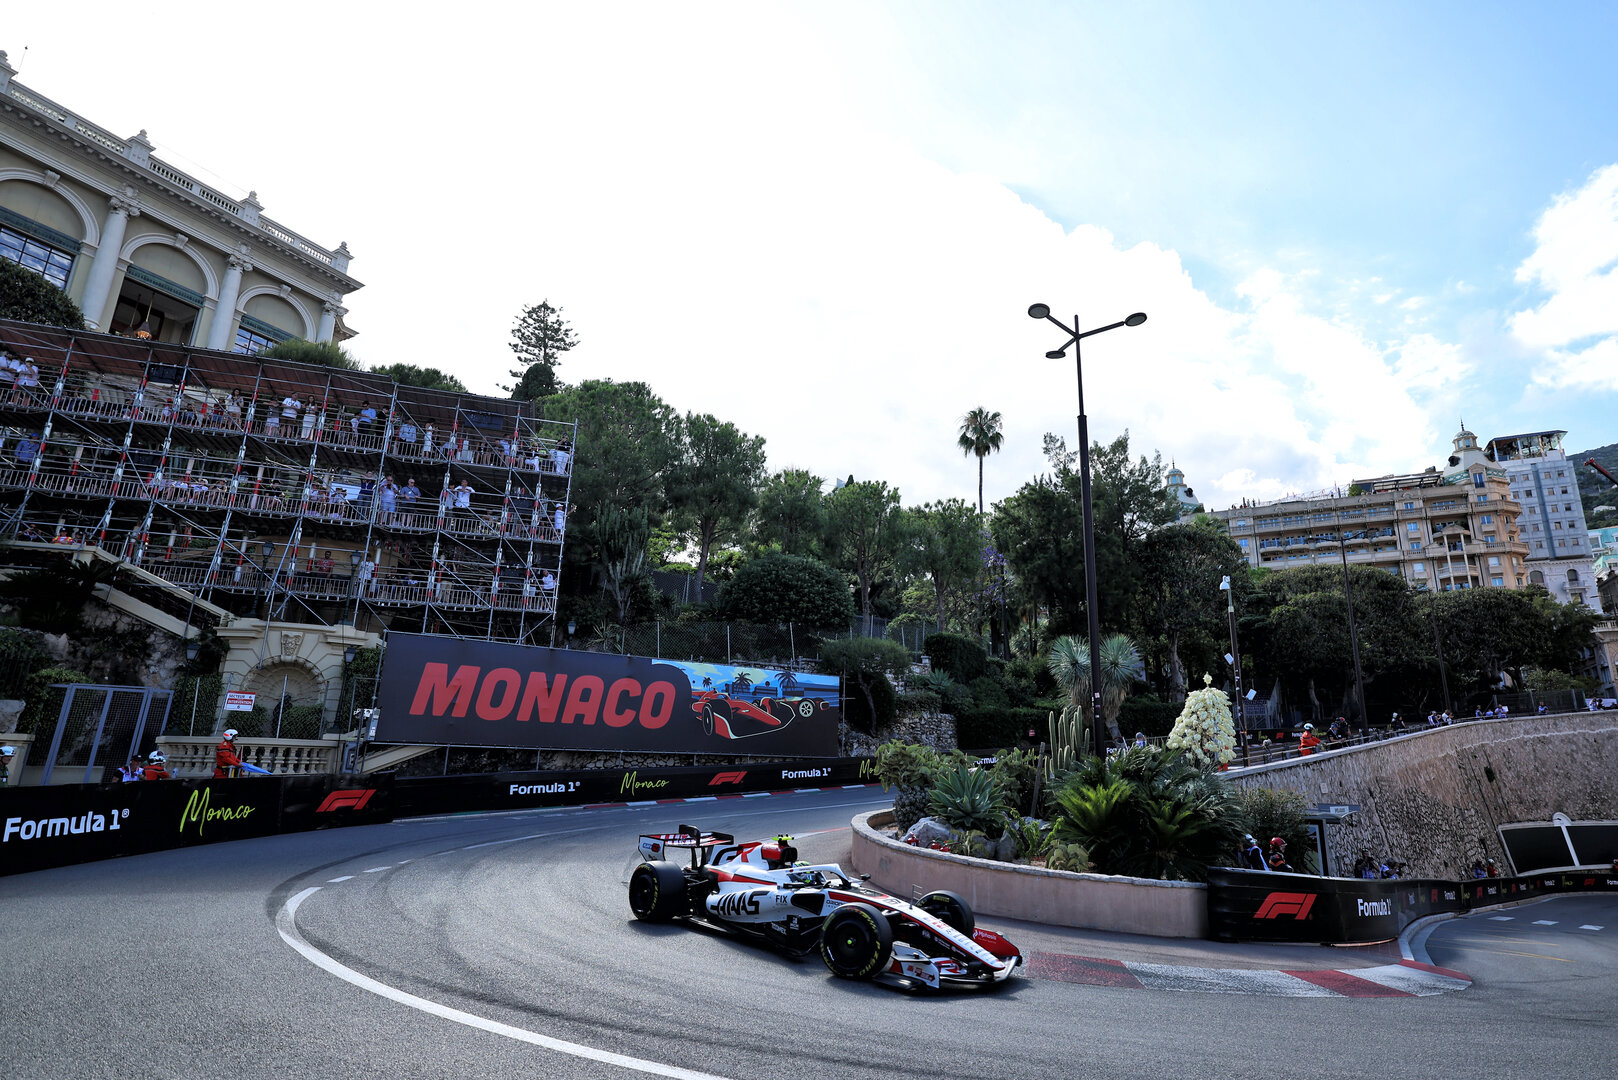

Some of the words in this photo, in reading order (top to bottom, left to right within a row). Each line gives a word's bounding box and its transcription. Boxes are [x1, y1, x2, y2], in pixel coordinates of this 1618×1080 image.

[409, 662, 676, 730] MONACO
[620, 771, 669, 796] Monaco
[782, 768, 820, 779] Formula
[509, 782, 566, 795] Formula
[179, 787, 256, 836] Monaco
[3, 811, 105, 842] Formula
[709, 890, 770, 916] HAAS
[775, 894, 788, 904] FIX
[1357, 898, 1387, 917] Formula
